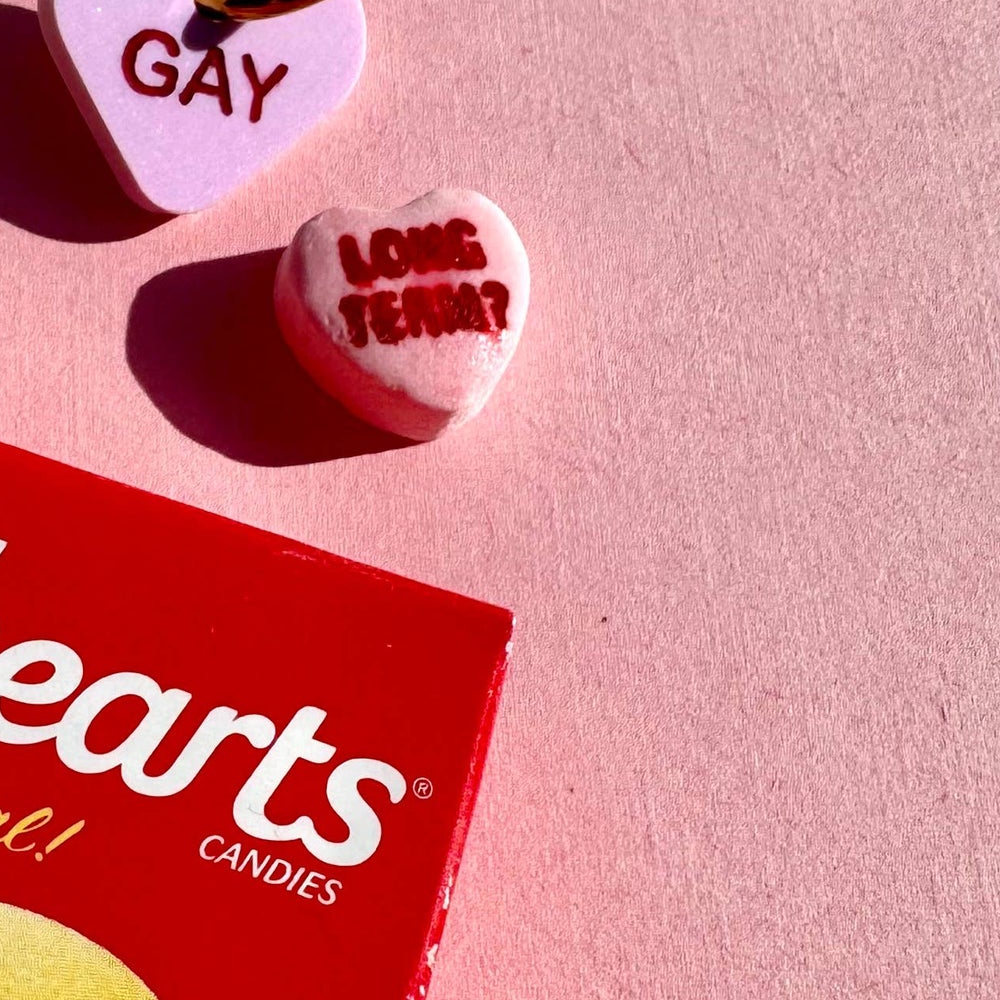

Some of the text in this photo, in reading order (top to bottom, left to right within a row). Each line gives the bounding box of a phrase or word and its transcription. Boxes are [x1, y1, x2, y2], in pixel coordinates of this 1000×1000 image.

[121, 28, 289, 123] GAY
[337, 217, 488, 288] LONG
[199, 834, 343, 906] CANDIES
